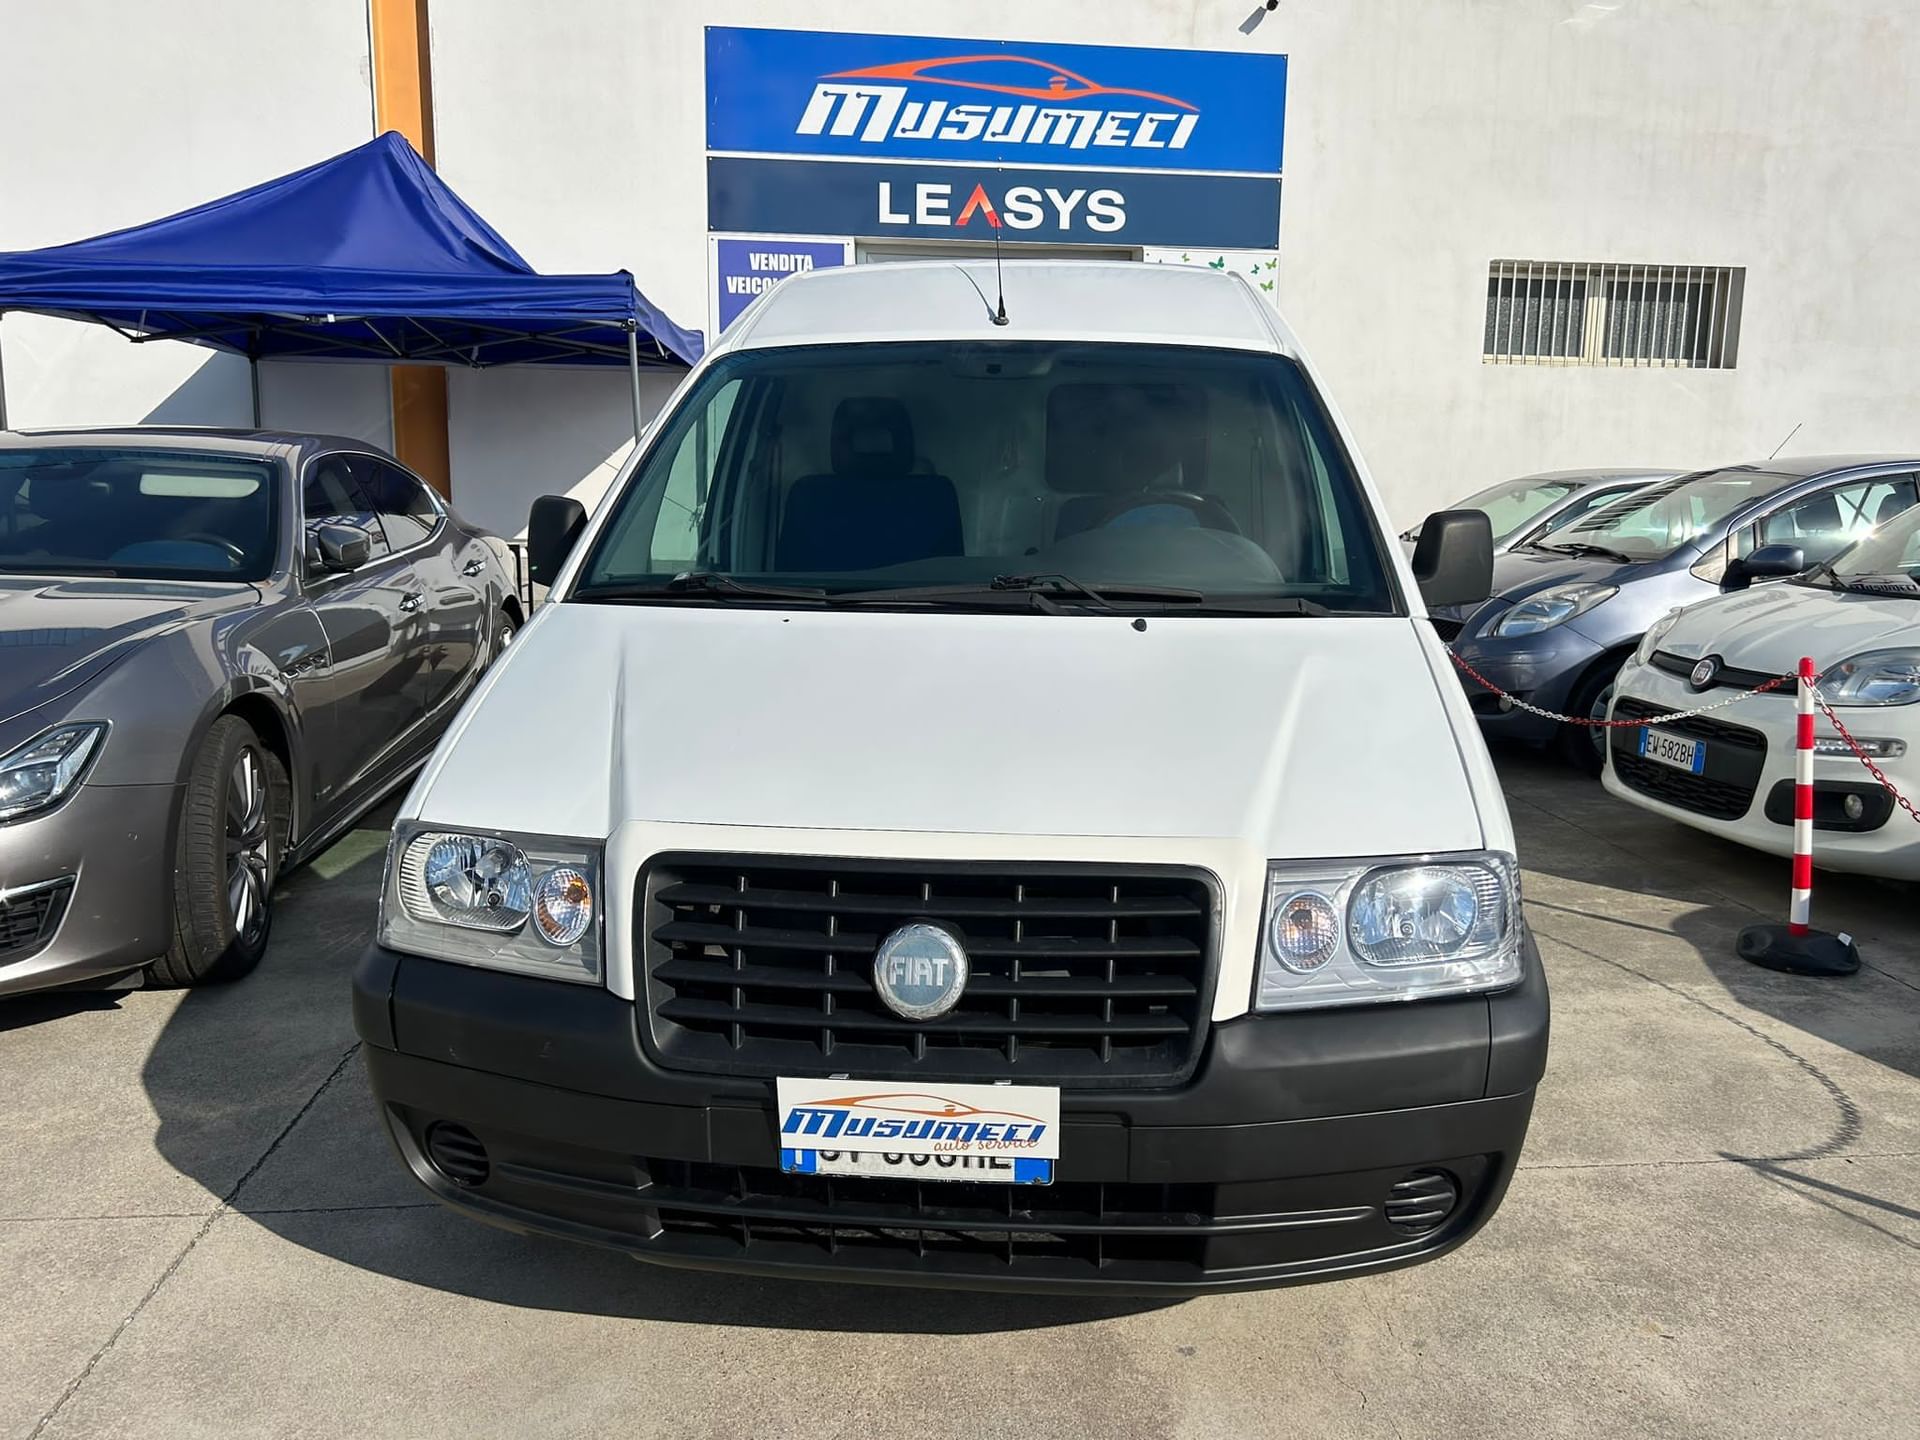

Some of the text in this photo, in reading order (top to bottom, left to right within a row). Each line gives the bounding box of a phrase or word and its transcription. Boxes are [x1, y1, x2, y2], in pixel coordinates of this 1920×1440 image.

[795, 83, 1200, 150] MUSUMECI
[878, 182, 1127, 233] LEASYS
[749, 252, 814, 272] VENDITA
[889, 956, 949, 987] FIAT
[782, 1107, 1047, 1143] MUSUMECI
[933, 1137, 1039, 1152] auto service
